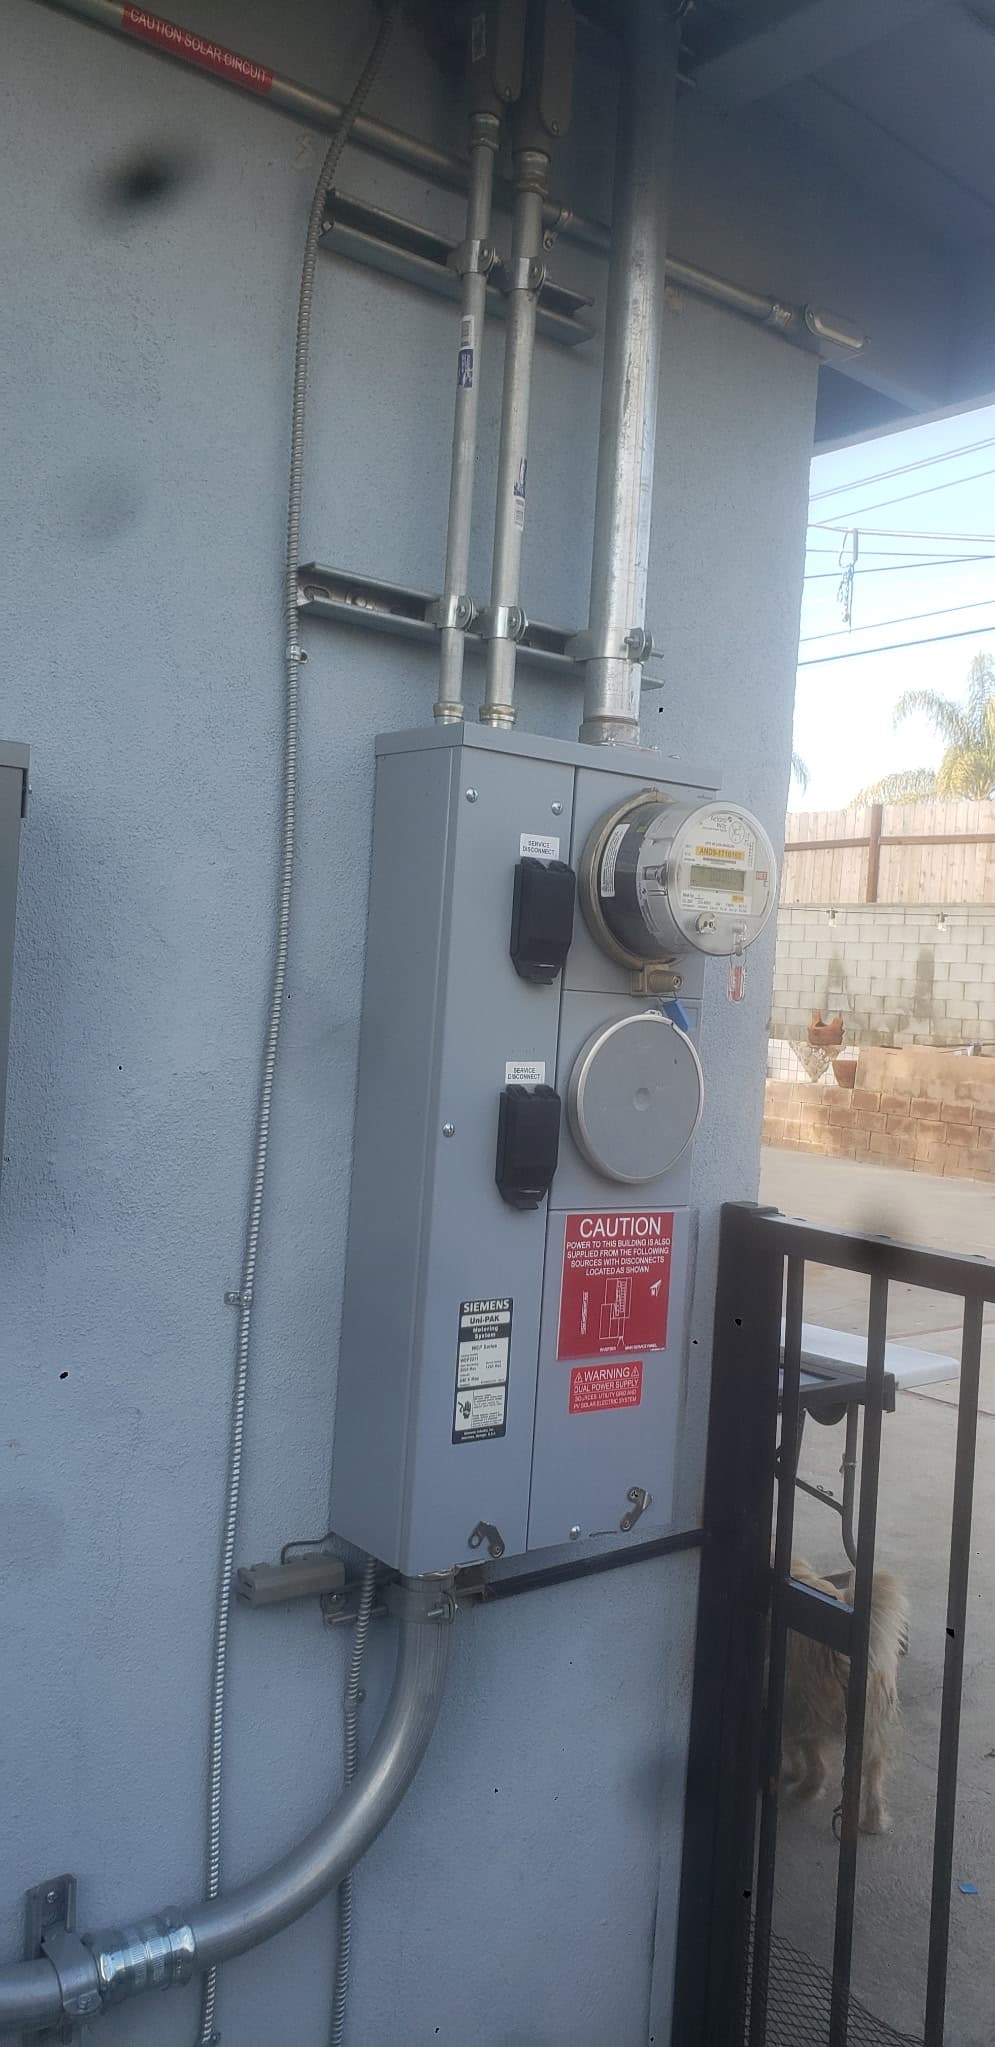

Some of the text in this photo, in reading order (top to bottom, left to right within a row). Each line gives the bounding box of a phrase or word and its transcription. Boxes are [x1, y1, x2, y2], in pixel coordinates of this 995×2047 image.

[130, 8, 267, 82] CAUTION SOLAR CIRCUIT
[522, 845, 555, 855] DISCONNECT
[528, 840, 551, 848] SERVICE
[580, 1216, 661, 1238] CAUTION
[566, 1238, 671, 1249] POWER TO THIS BUILDING IS ALSO
[567, 1246, 669, 1259] SUPPLIED FROM THE FOLLOWING
[570, 1255, 665, 1268] SOURCES WITH DISCONNECTS
[585, 1265, 650, 1276] LOCATED AS SHOWN
[463, 1299, 510, 1313] SIEMENS
[474, 1332, 496, 1340] System
[584, 1366, 630, 1382] WARNING
[573, 1379, 639, 1394] DUAL POWER SUPPLY
[598, 1391, 616, 1399] UTILITY
[596, 1398, 619, 1407] ELECTRIC
[619, 1396, 637, 1404] SYSTEM
